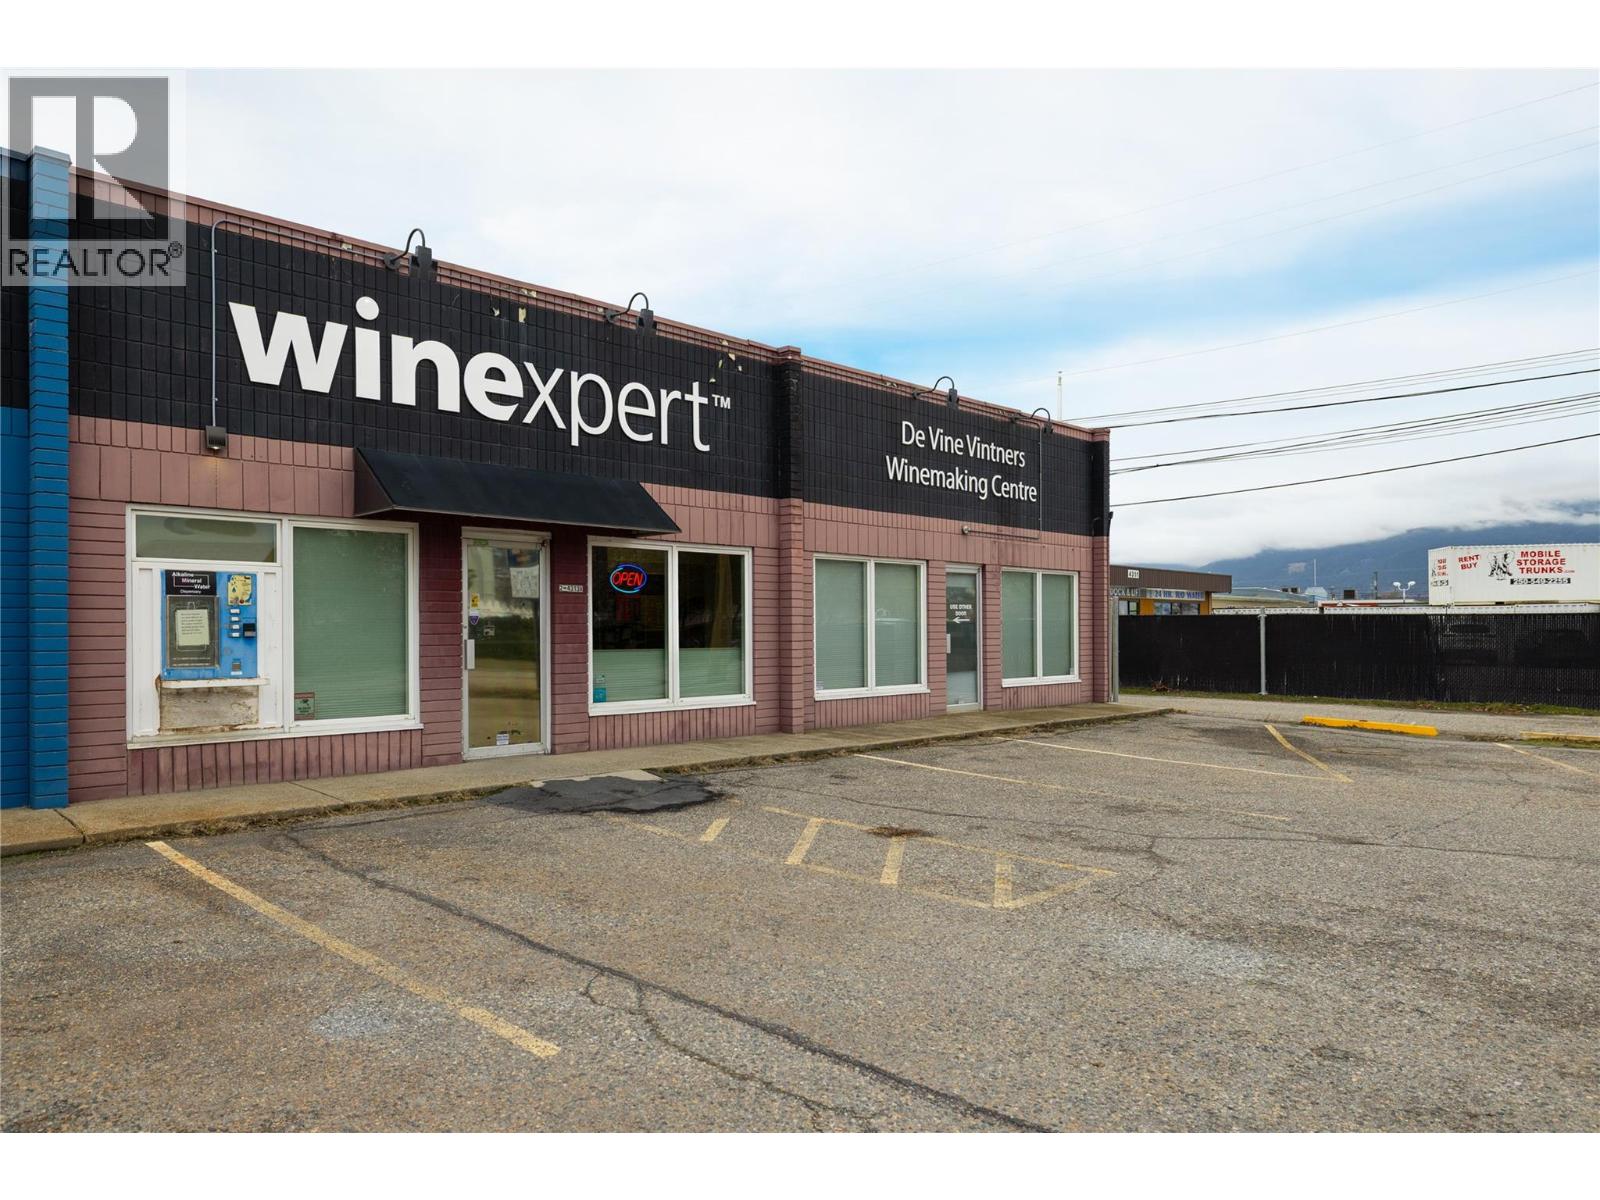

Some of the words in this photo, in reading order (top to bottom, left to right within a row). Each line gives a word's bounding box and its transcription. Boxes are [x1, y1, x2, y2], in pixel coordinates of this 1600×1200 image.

[901, 420, 926, 448] De
[928, 426, 964, 456] Vine
[966, 434, 1026, 468] Vintners
[885, 455, 988, 500] Winemaking
[991, 475, 1038, 502] Centre
[1458, 554, 1480, 563] RENT
[1520, 550, 1561, 558] MOBILE
[1460, 562, 1478, 570] BUY
[1516, 558, 1566, 566] STORAGE
[612, 572, 643, 586] OPEN
